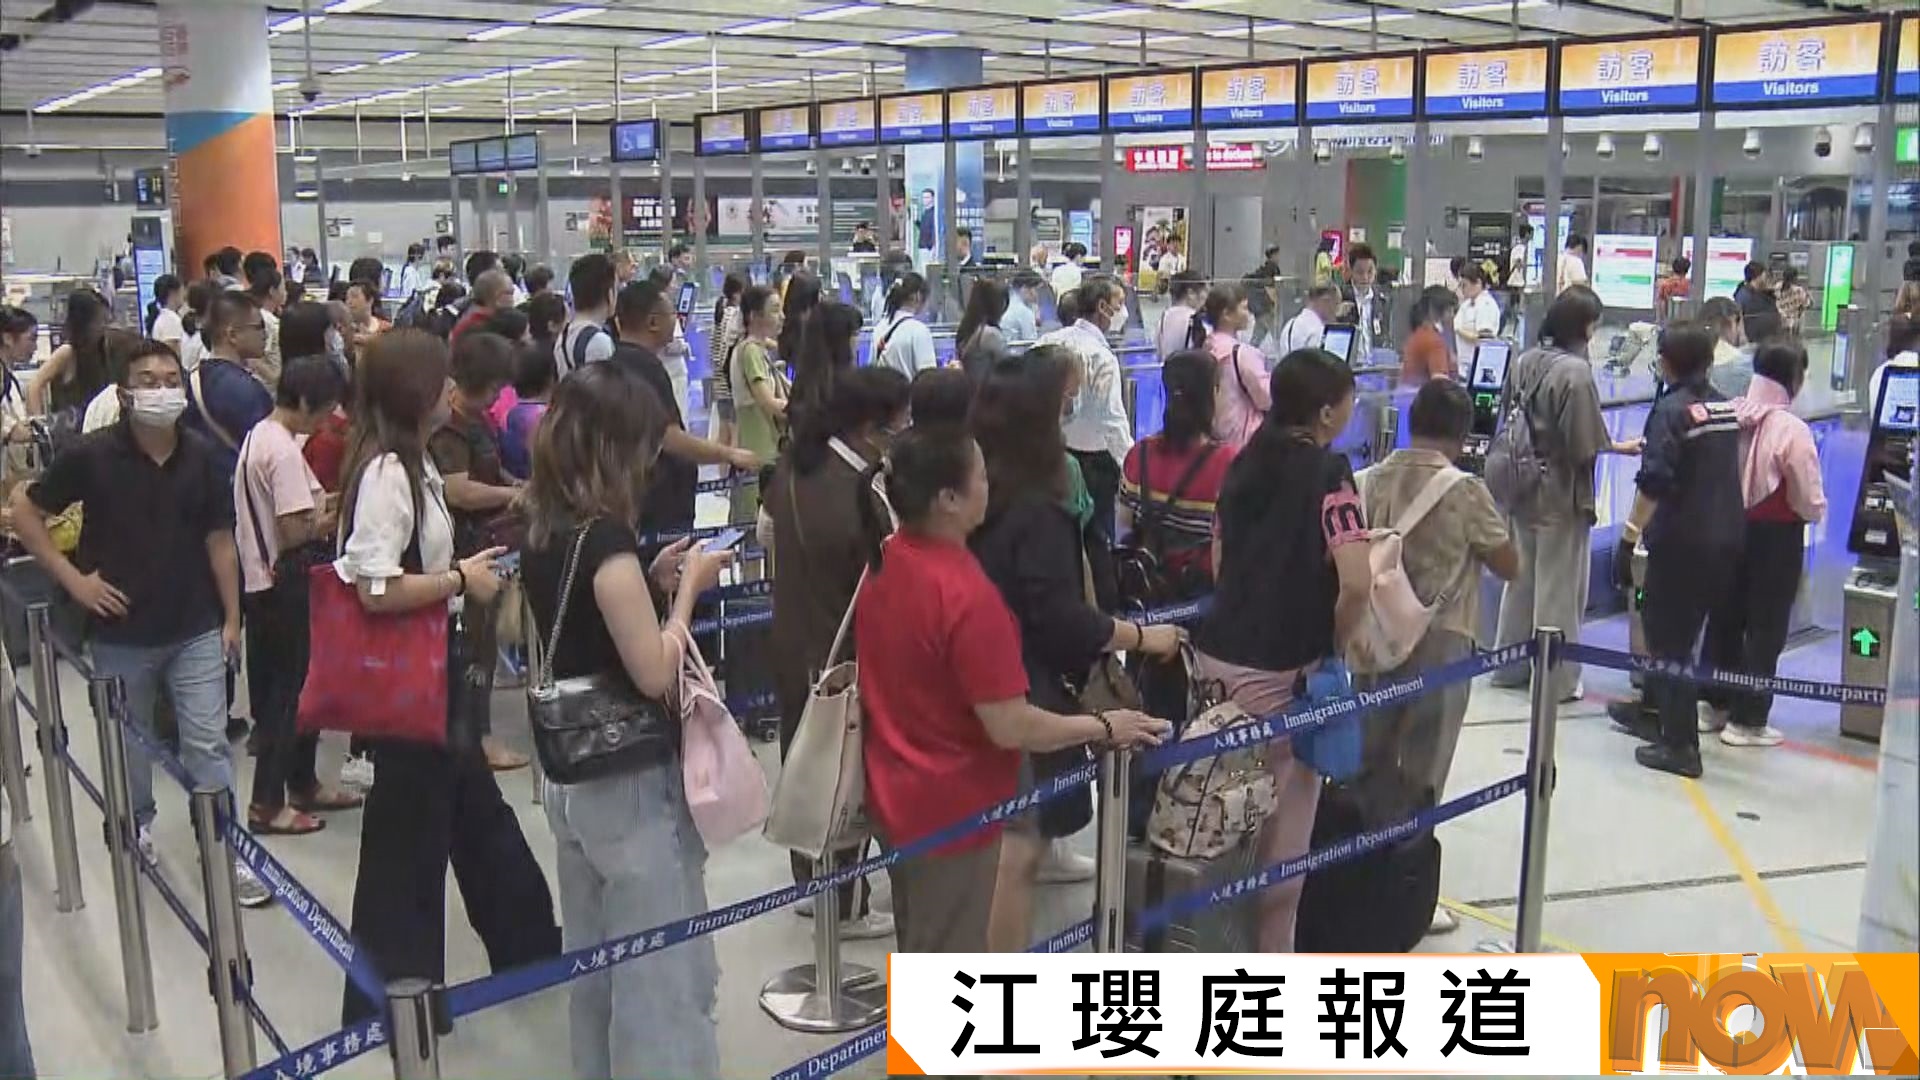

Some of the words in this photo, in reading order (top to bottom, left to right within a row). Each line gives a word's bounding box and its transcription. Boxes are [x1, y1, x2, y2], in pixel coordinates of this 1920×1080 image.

[1599, 51, 1654, 81] 訪客
[1760, 38, 1826, 72] 訪客
[1337, 67, 1380, 95] 訪客
[1458, 60, 1507, 88] 訪客
[1763, 80, 1820, 95] Visitors
[1339, 101, 1376, 114] Visitors
[1461, 96, 1504, 110] Visitors
[1601, 89, 1650, 103] Visitors
[1230, 107, 1264, 119] Visitors
[1713, 668, 1814, 694] Immigration
[1283, 698, 1357, 730] Immigration
[1358, 676, 1424, 707] Department
[1280, 843, 1352, 877] Immigration
[1356, 817, 1419, 848] Department
[686, 889, 798, 936] Immigration
[804, 852, 900, 896] Department
[261, 856, 310, 914] Immigration
[308, 902, 355, 962] Department
